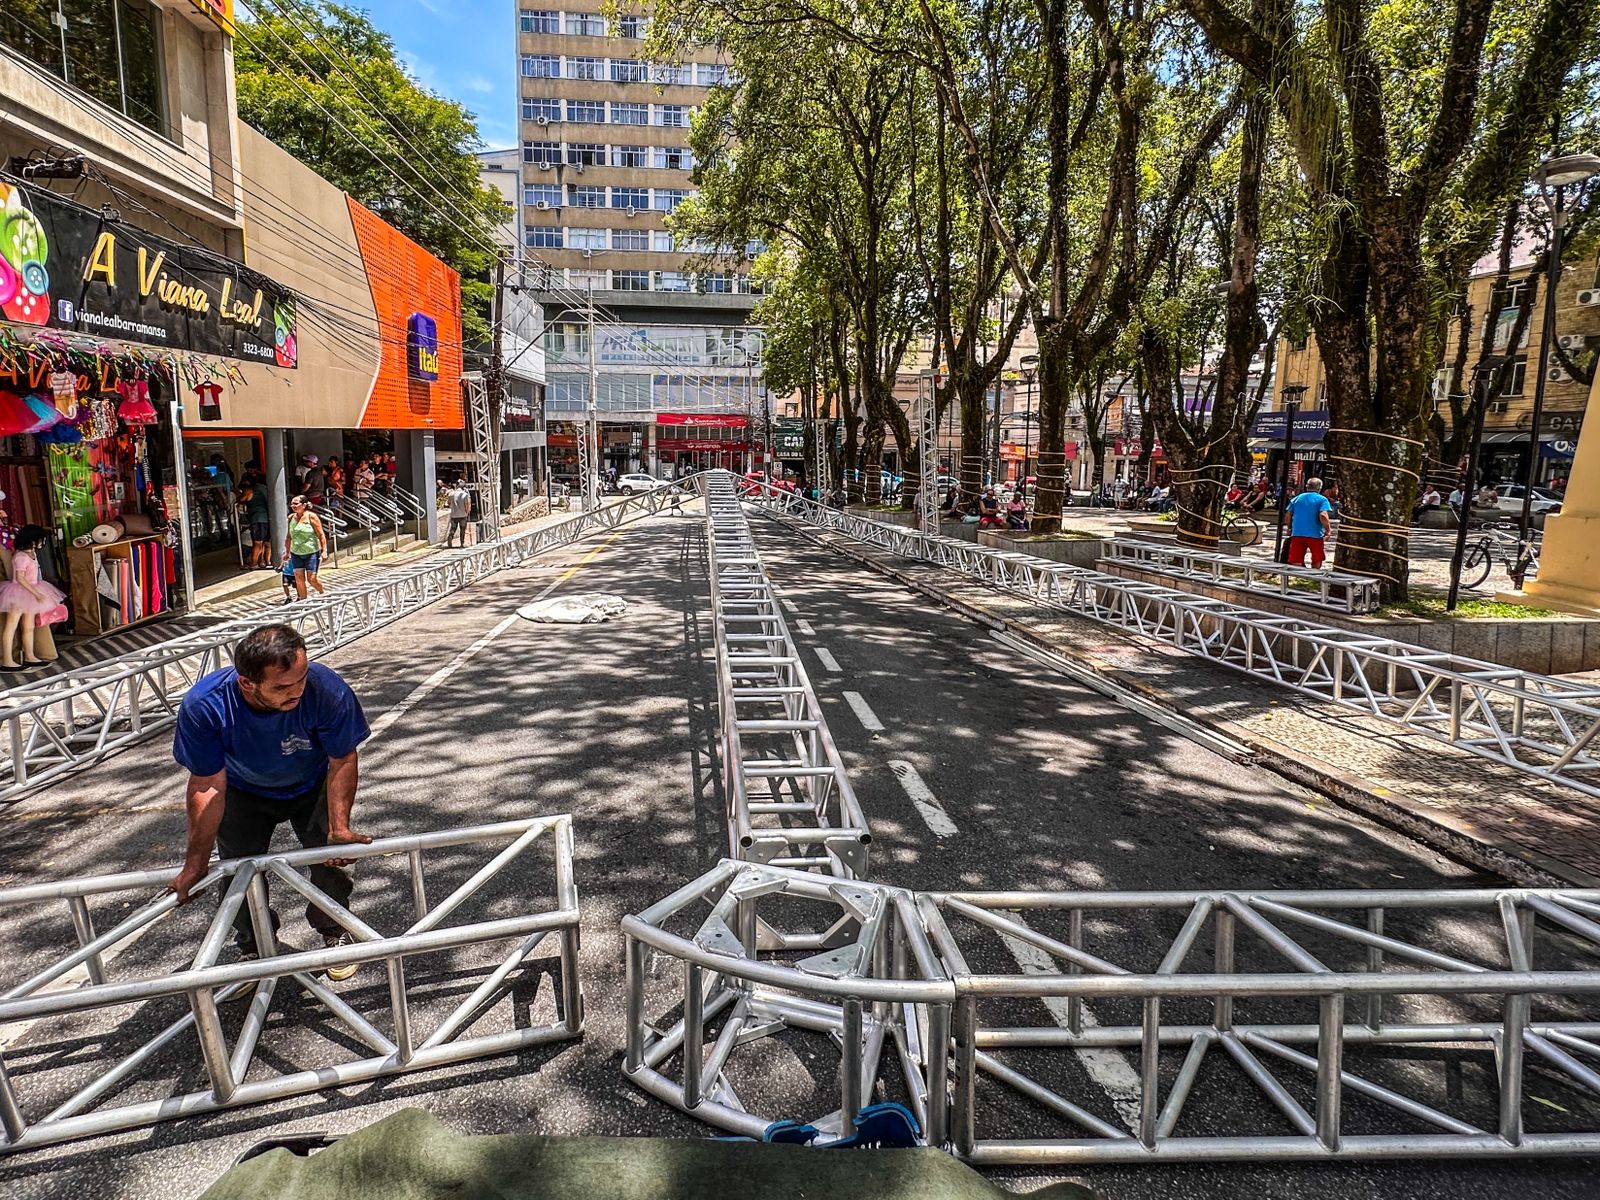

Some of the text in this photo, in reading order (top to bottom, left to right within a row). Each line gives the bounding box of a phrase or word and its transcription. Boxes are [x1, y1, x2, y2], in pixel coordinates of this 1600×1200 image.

[83, 232, 263, 328] A Viana Leal
[75, 308, 166, 338] vianalealbarramansa
[243, 342, 274, 358] 3323-6800
[418, 347, 439, 374] Itaú
[1292, 420, 1331, 429] DENTISTAS
